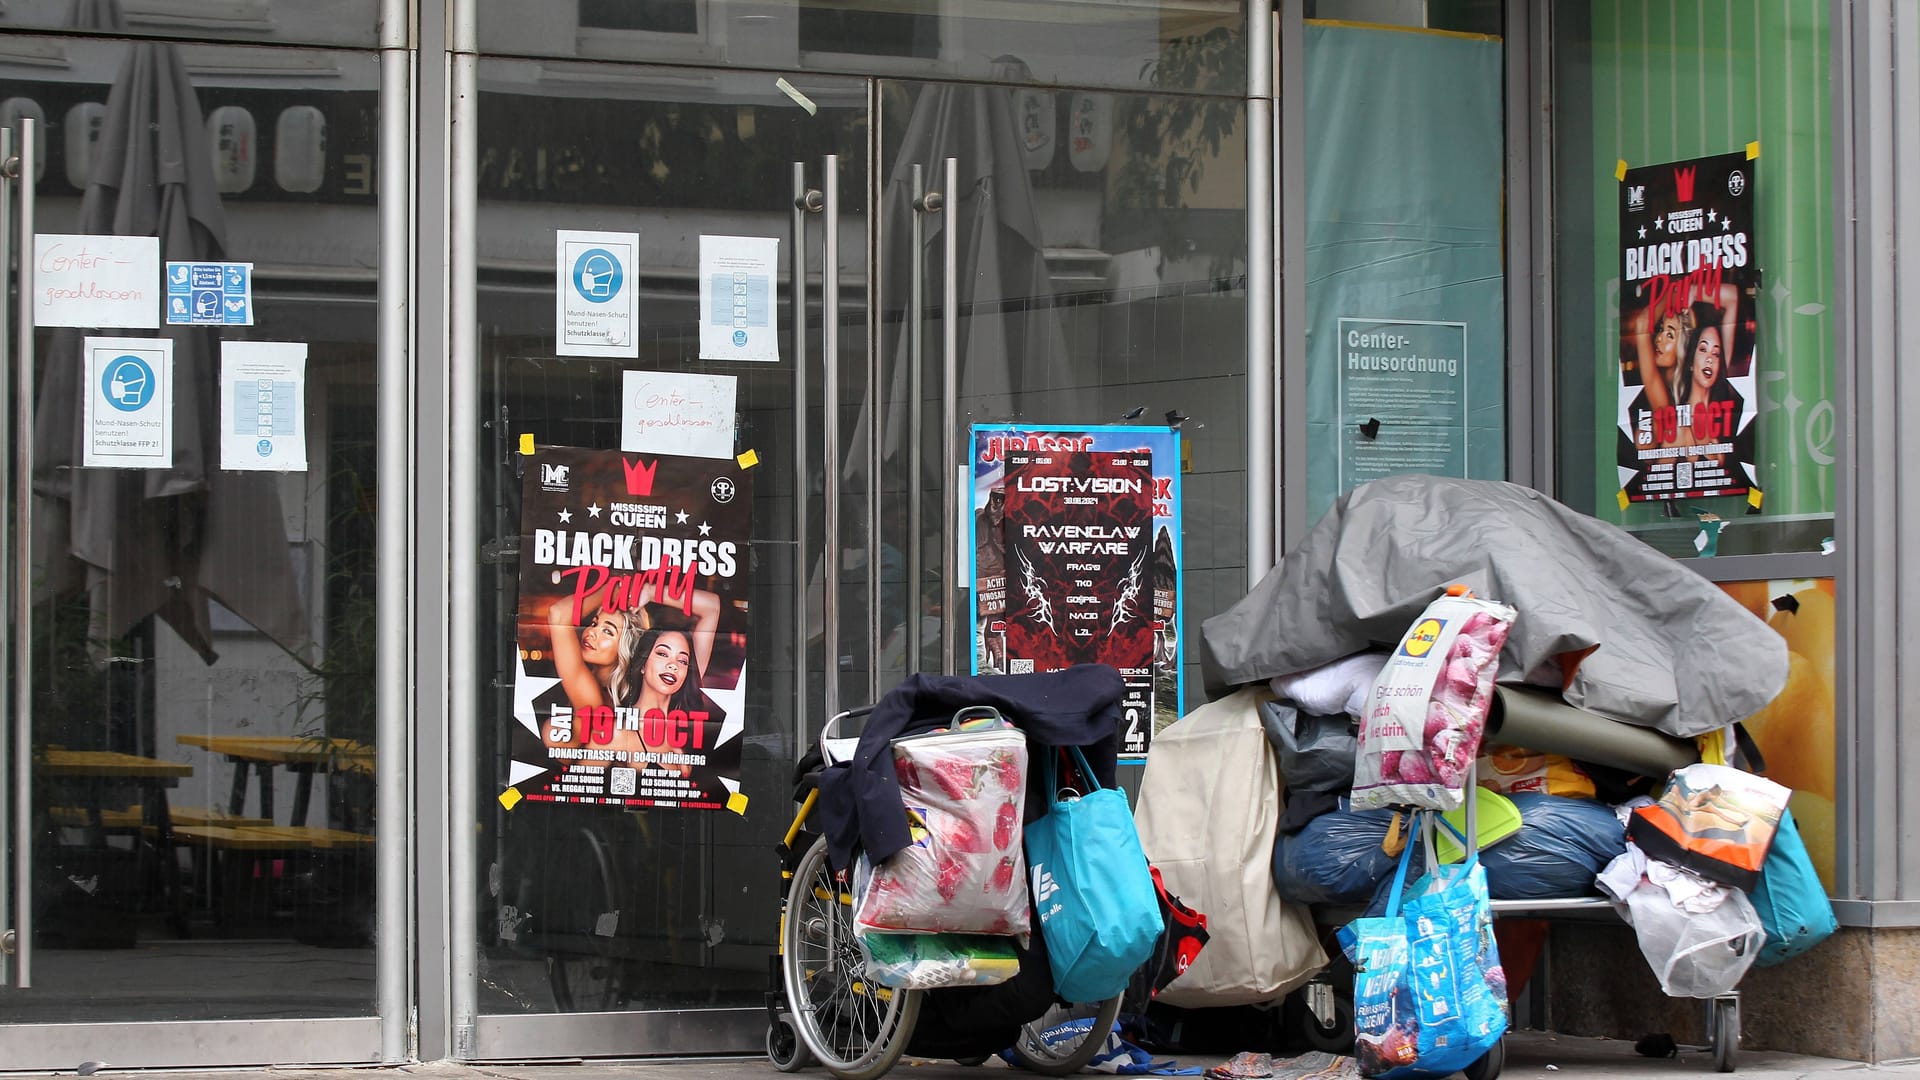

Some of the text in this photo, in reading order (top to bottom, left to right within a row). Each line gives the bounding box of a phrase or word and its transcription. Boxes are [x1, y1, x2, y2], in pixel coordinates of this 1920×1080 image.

[1668, 217, 1703, 234] QUEEN
[1626, 232, 1748, 281] BLACK DRESS
[1641, 254, 1723, 333] Party
[567, 310, 628, 318] Mund-Nasen-Schutz
[1347, 330, 1410, 350] Center-
[1347, 352, 1457, 377] Hausordnung
[95, 419, 161, 428] Mund-Nasen-Schutz
[1638, 408, 1652, 445] SAT
[1694, 400, 1736, 440] OCT
[95, 439, 136, 447] Schutzklasse
[138, 440, 150, 448] FFP
[982, 436, 1094, 462] JURASSIC
[1017, 476, 1142, 494] LOST:VISION
[610, 502, 666, 515] MISSISSIPPI
[610, 512, 666, 528] QUEEN
[1024, 526, 1140, 540] RAVENCLAW
[534, 528, 736, 578] BLACK DRESS
[1038, 542, 1128, 555] WARFARE
[561, 554, 698, 626] Party
[1066, 596, 1101, 605] GOSPEL
[1394, 684, 1424, 697] schön
[1122, 700, 1146, 708] Sonntag,
[550, 704, 573, 744] SAT
[644, 708, 710, 750] OCT
[1125, 744, 1144, 752] JUNI
[548, 747, 706, 766] DONAUSTRASSE 40 90451 NÜRNBERG
[569, 764, 604, 774] AFRO BEATS
[642, 768, 657, 777] PURE
[668, 770, 681, 778] HOP
[562, 774, 604, 784] LATIN SOUNDS
[641, 778, 652, 786] OLD
[653, 779, 676, 788] SCHOOL
[551, 784, 604, 794] VS. REGGAE VIBES
[640, 788, 701, 798] OLD SCHOOL HIP HOP
